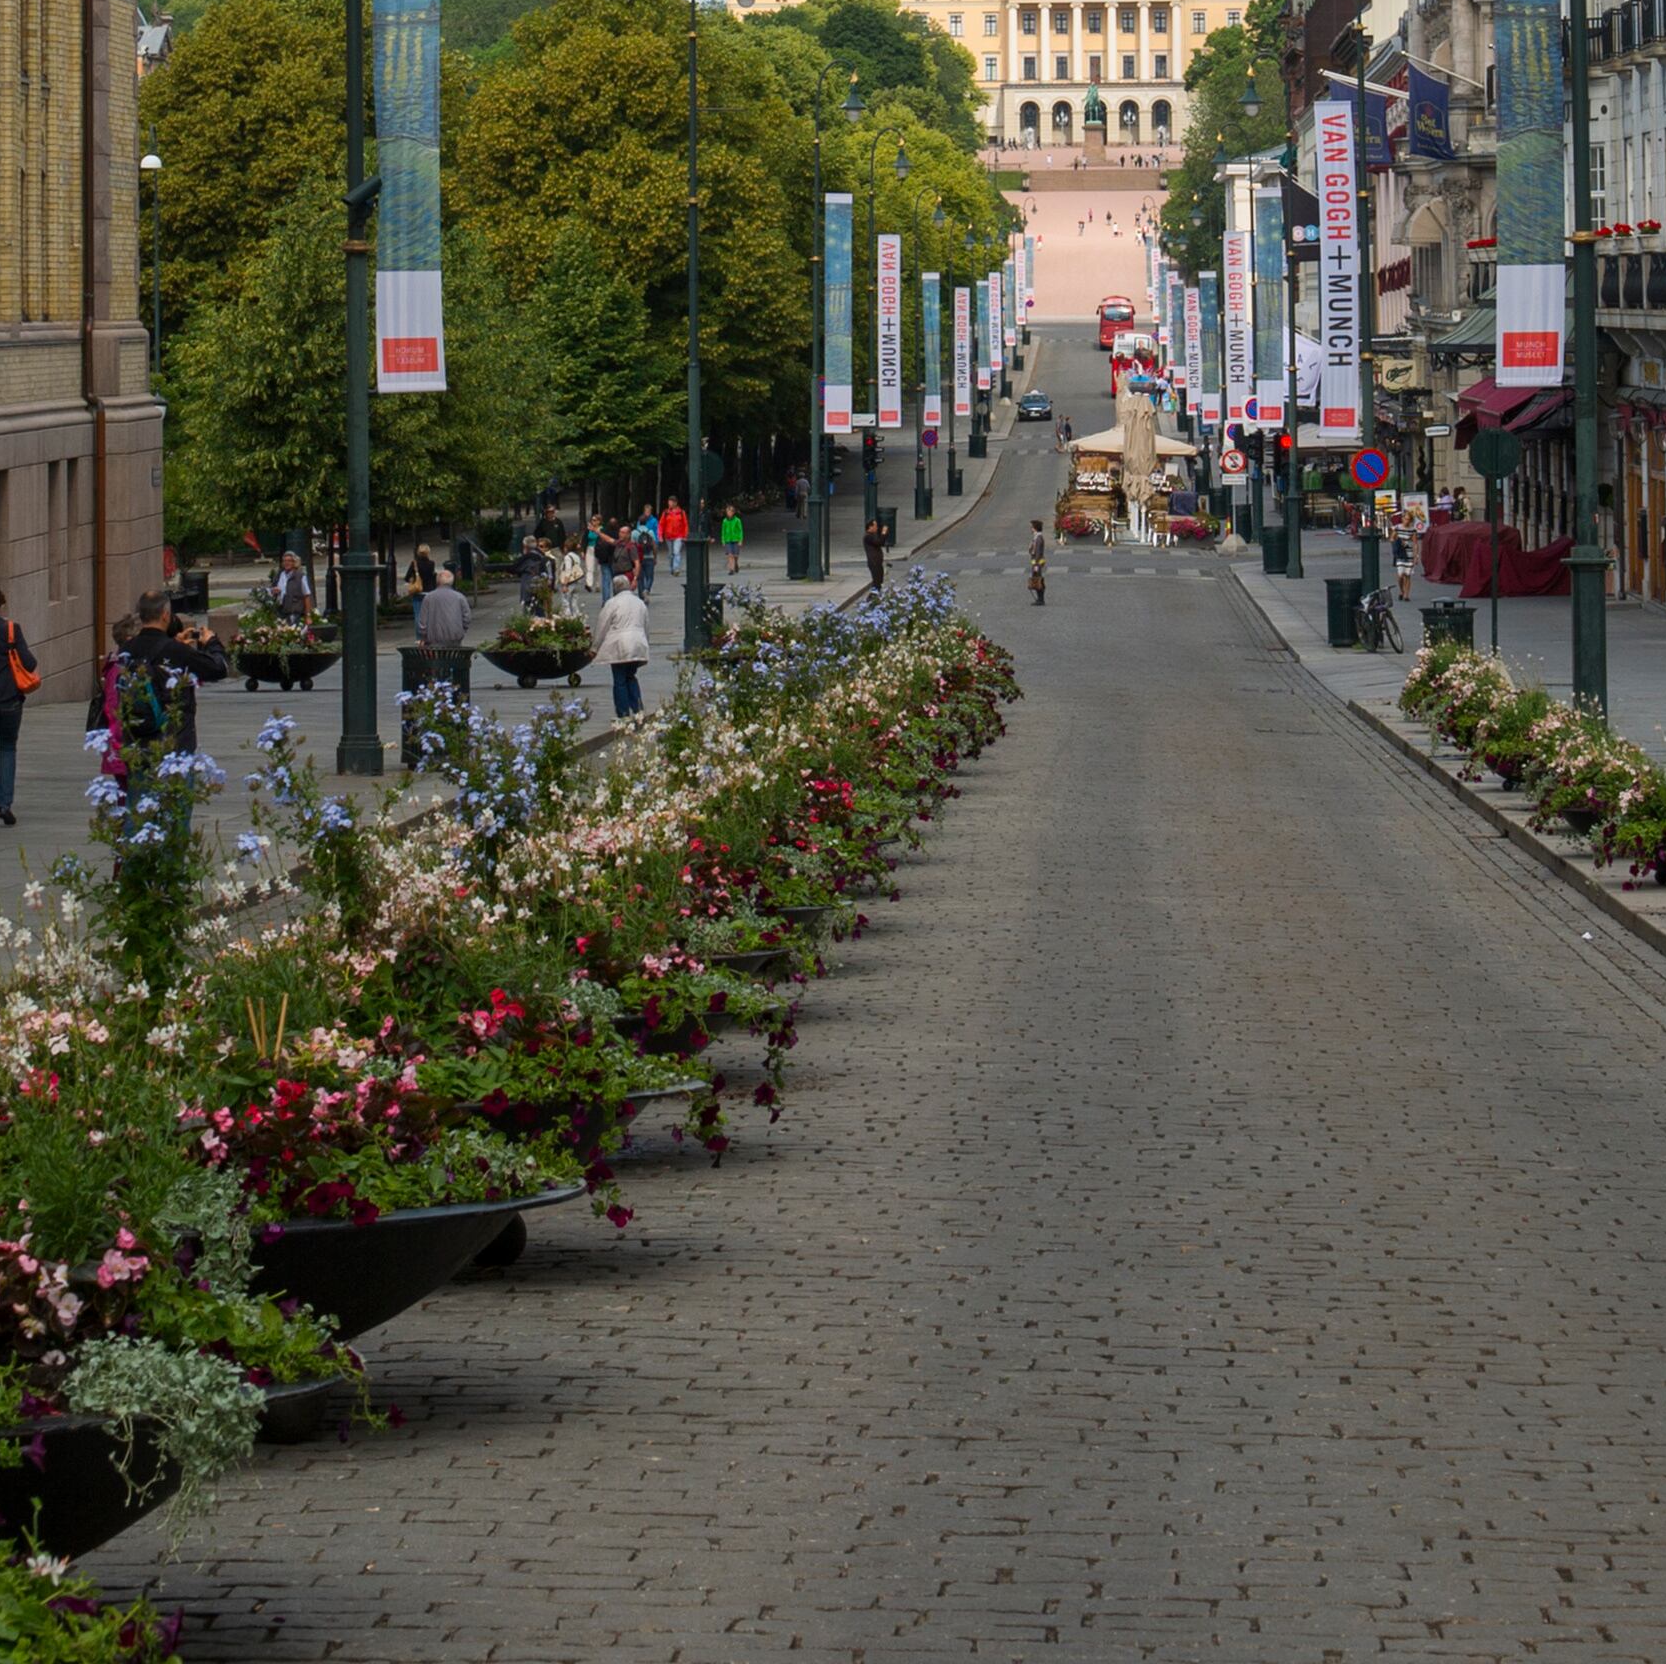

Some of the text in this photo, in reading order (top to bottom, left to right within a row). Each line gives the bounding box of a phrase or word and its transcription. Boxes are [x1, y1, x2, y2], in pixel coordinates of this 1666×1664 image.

[1321, 113, 1348, 163] VAN
[1325, 173, 1351, 241] GOGH
[1228, 239, 1242, 267] VAN
[1187, 293, 1197, 312] VAN
[1229, 271, 1244, 312] GOGH
[1328, 274, 1353, 367] MUNCH
[1230, 330, 1245, 383] MUNCH
